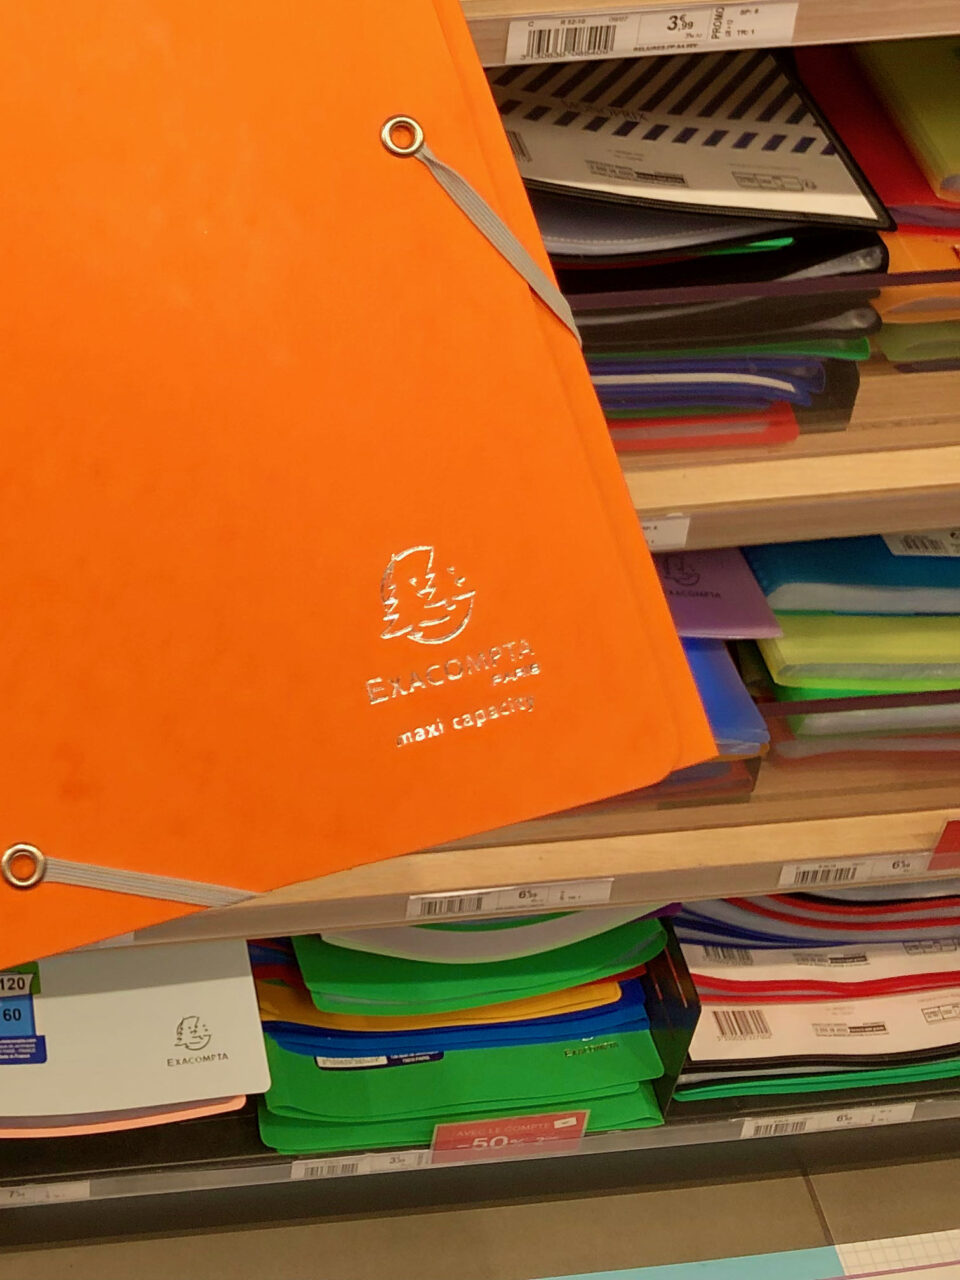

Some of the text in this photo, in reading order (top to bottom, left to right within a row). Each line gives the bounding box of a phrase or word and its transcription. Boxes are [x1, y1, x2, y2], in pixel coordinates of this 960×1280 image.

[711, 6, 725, 40] PROMO
[365, 639, 536, 705] EXACOMPTA
[397, 695, 534, 748] maxi capacity
[2, 1008, 22, 1021] 60
[167, 1053, 229, 1067] EXACOMPTA
